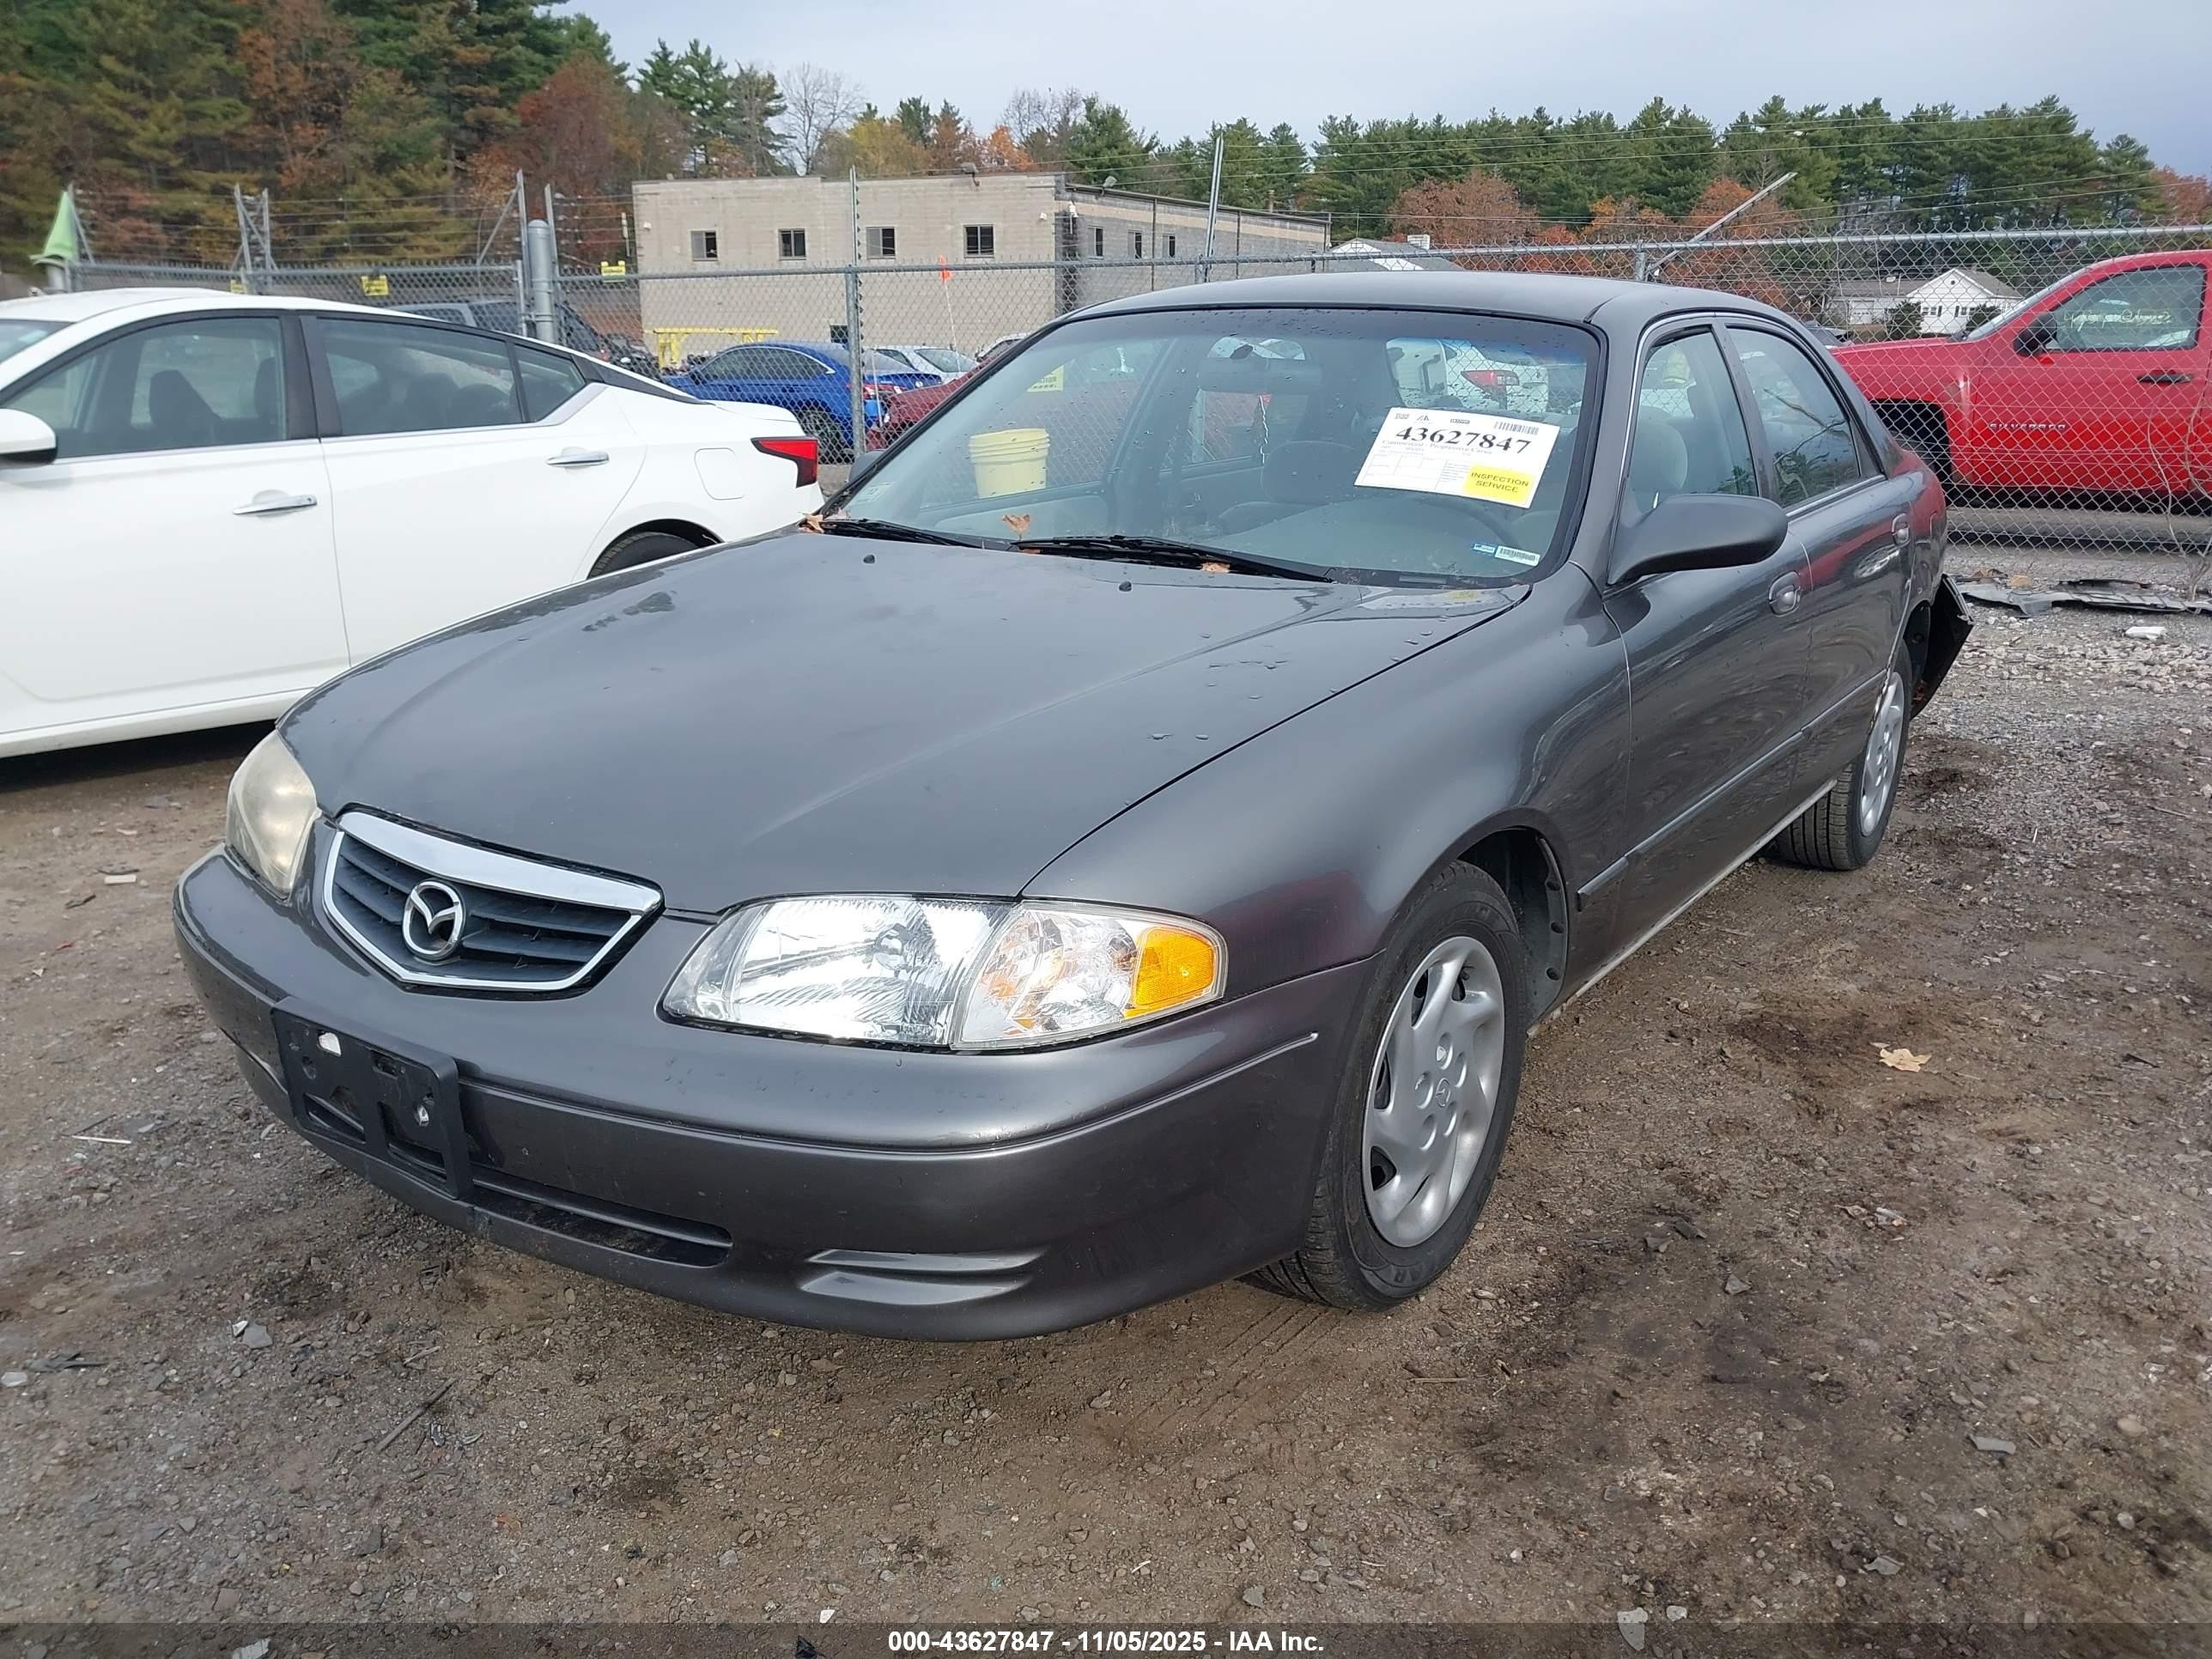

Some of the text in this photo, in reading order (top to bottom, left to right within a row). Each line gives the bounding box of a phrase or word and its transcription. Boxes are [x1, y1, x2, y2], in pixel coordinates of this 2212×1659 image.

[1395, 426, 1533, 454] 43627847
[1471, 471, 1529, 487] INSPECTION
[1475, 480, 1519, 493] SERVICE
